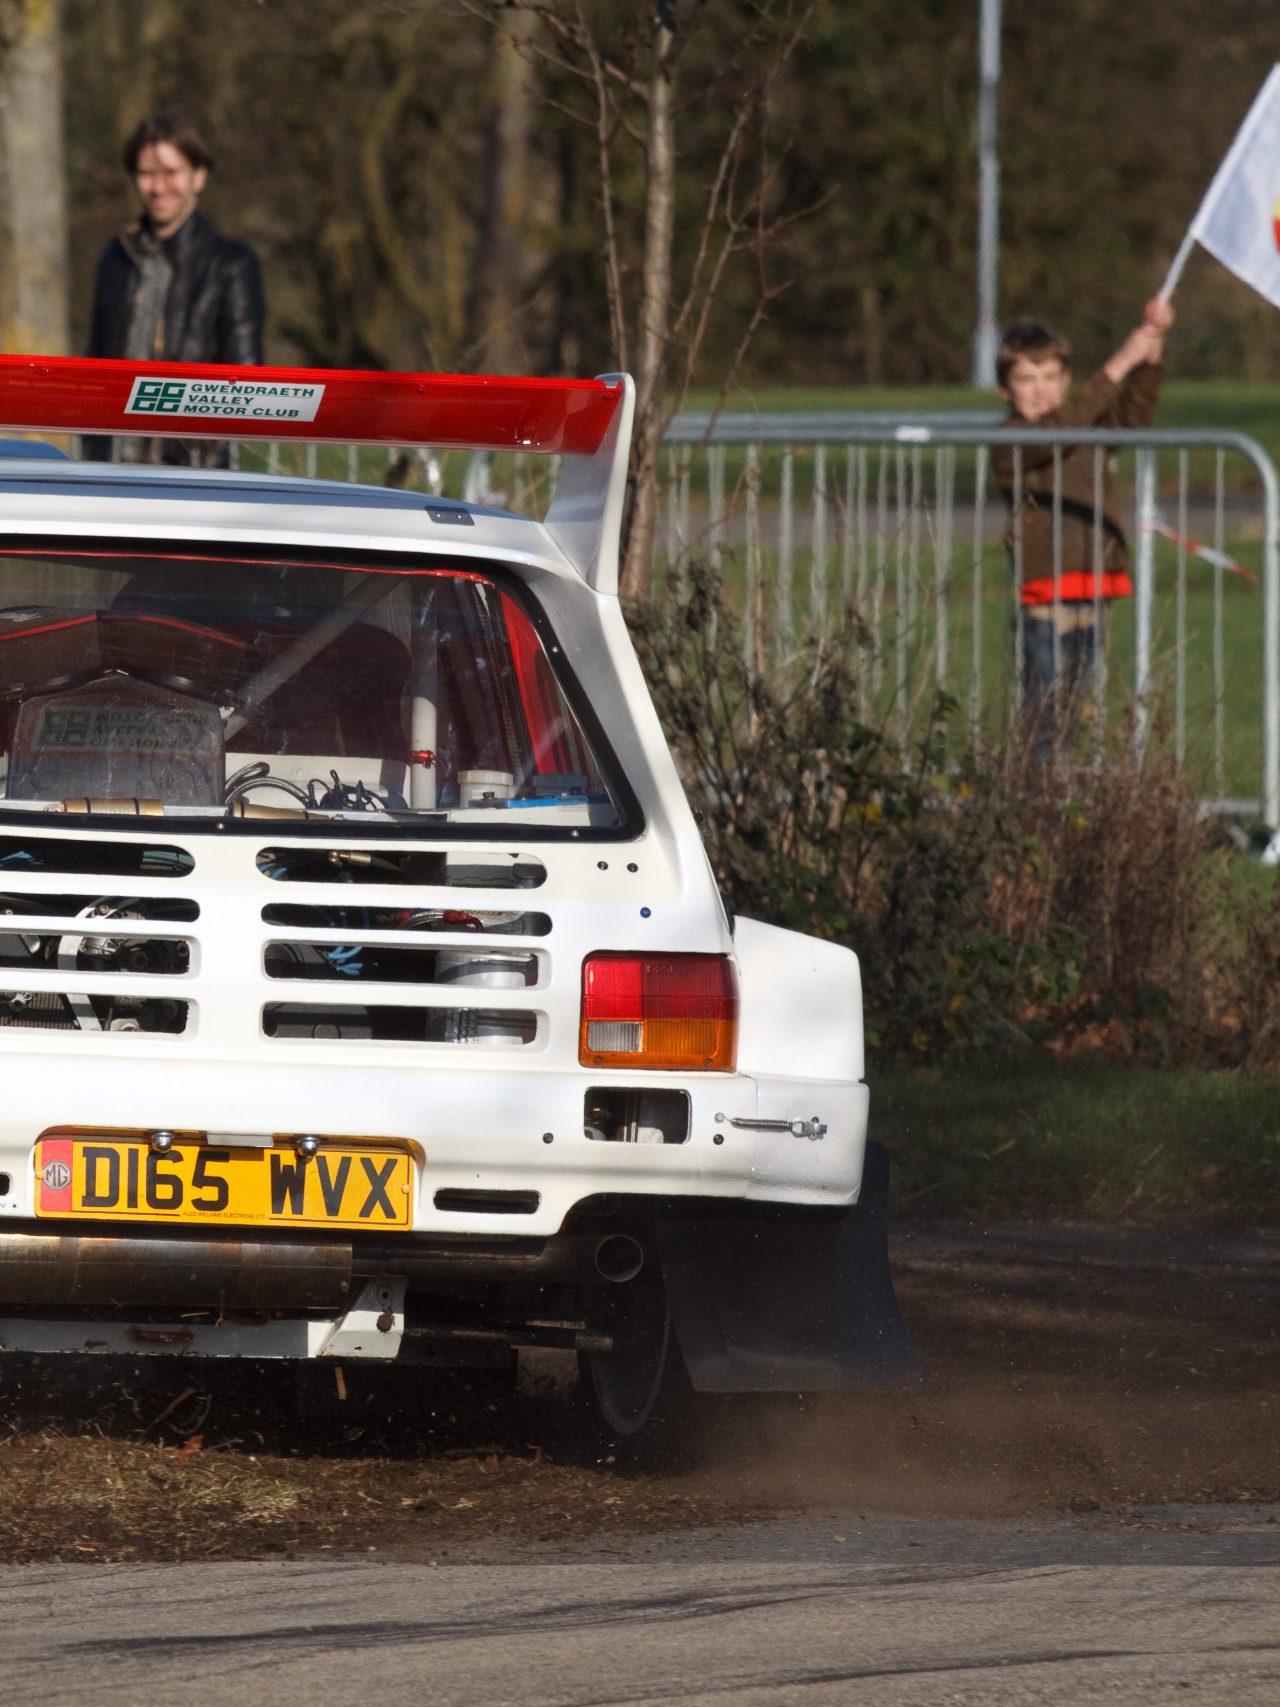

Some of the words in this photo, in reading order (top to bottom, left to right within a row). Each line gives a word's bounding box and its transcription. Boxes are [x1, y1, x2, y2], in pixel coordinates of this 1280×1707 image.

[190, 383, 315, 397] GWENDRAETH
[188, 394, 255, 405] VALLEY
[183, 404, 247, 415] MOTOR
[252, 407, 300, 417] CLUB
[46, 1163, 69, 1188] MG
[81, 1146, 230, 1212] D165
[270, 1153, 398, 1220] WVX
